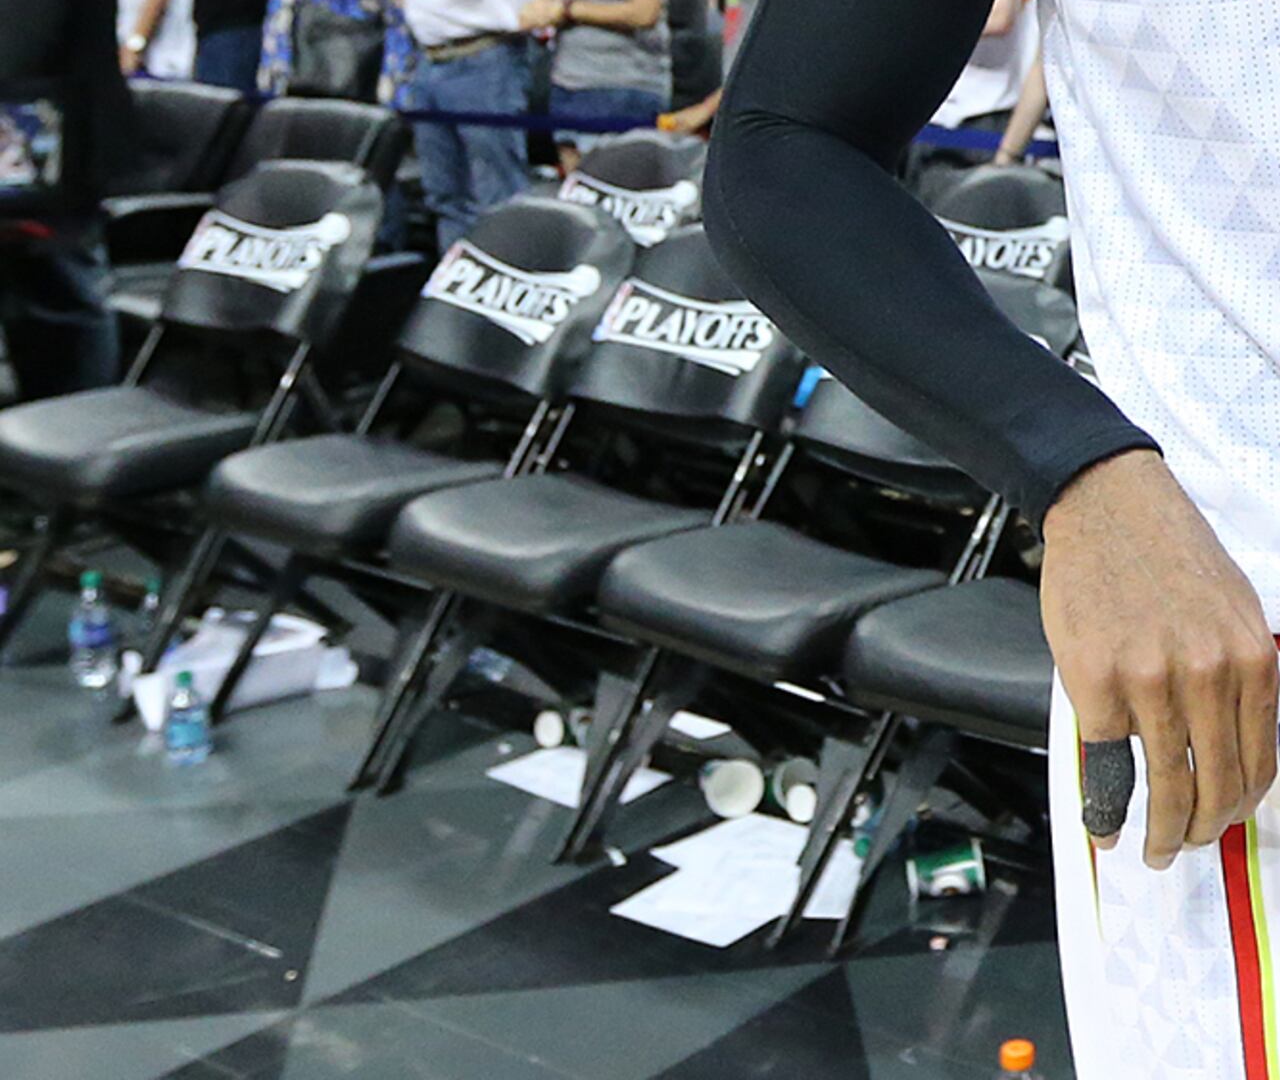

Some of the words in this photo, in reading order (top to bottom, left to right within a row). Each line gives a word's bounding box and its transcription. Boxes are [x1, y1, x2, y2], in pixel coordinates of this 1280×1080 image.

[198, 227, 325, 271] PLAYOFFS
[440, 260, 577, 322] PLAYOFFS
[614, 295, 775, 351] PLAYOFFS
